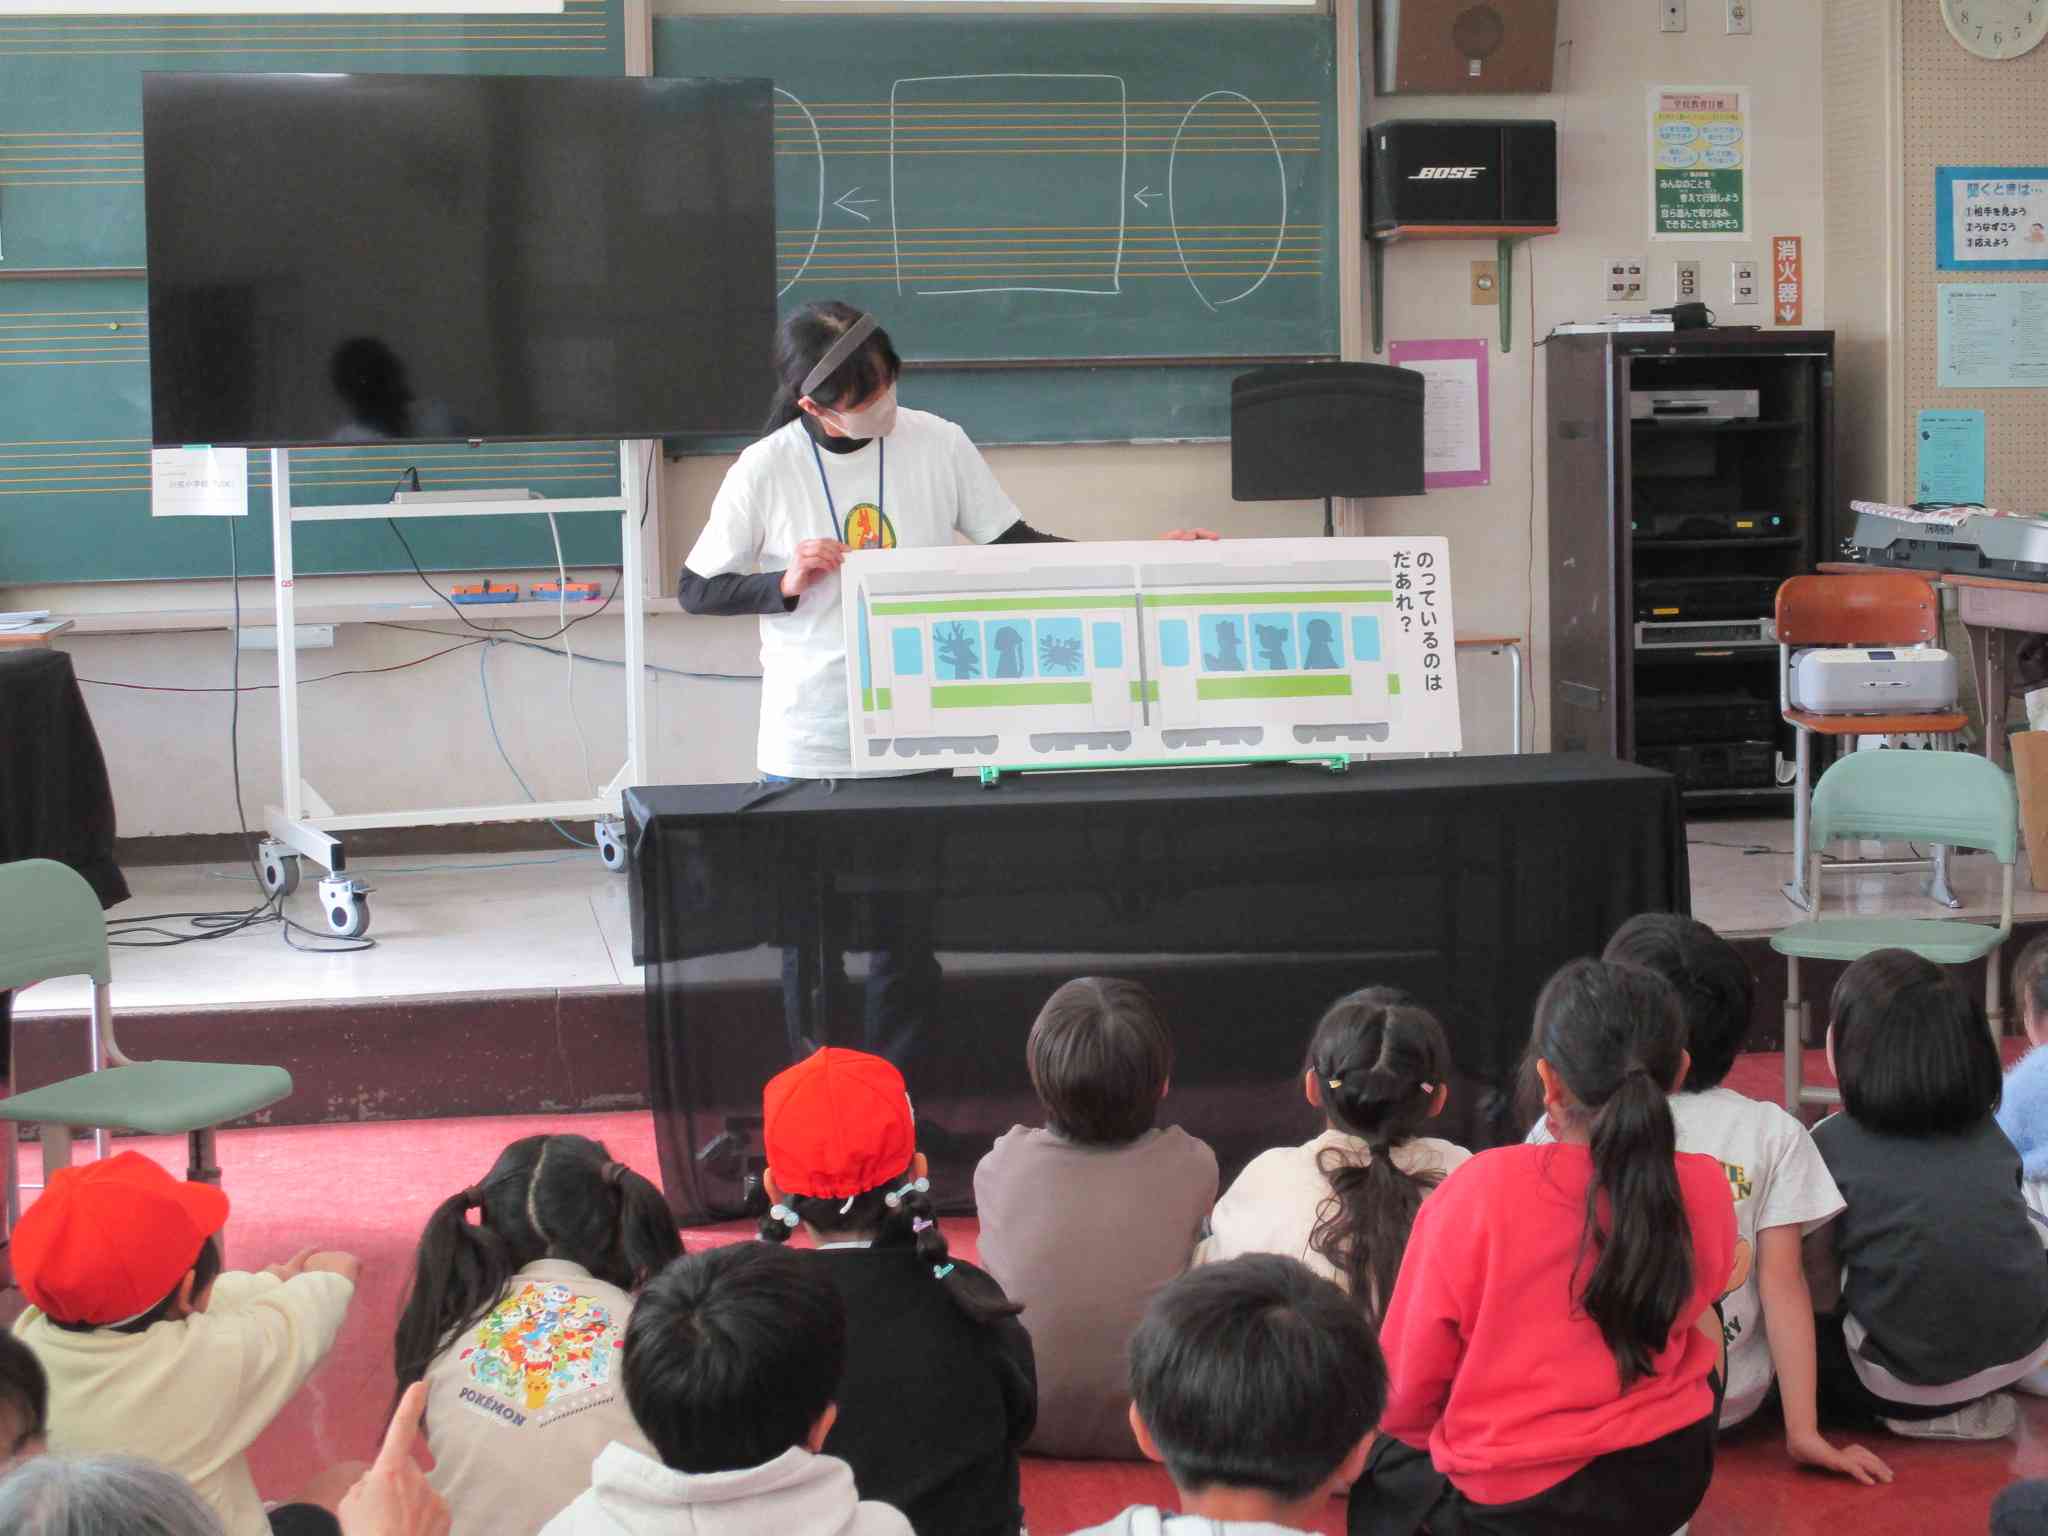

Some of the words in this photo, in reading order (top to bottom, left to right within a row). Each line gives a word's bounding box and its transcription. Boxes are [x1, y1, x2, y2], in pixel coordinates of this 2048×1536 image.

[1408, 166, 1487, 179] BOSE
[1776, 240, 1799, 303] 消火器
[1416, 551, 1443, 691] のっているのは
[459, 1387, 527, 1424] POKÉMON
